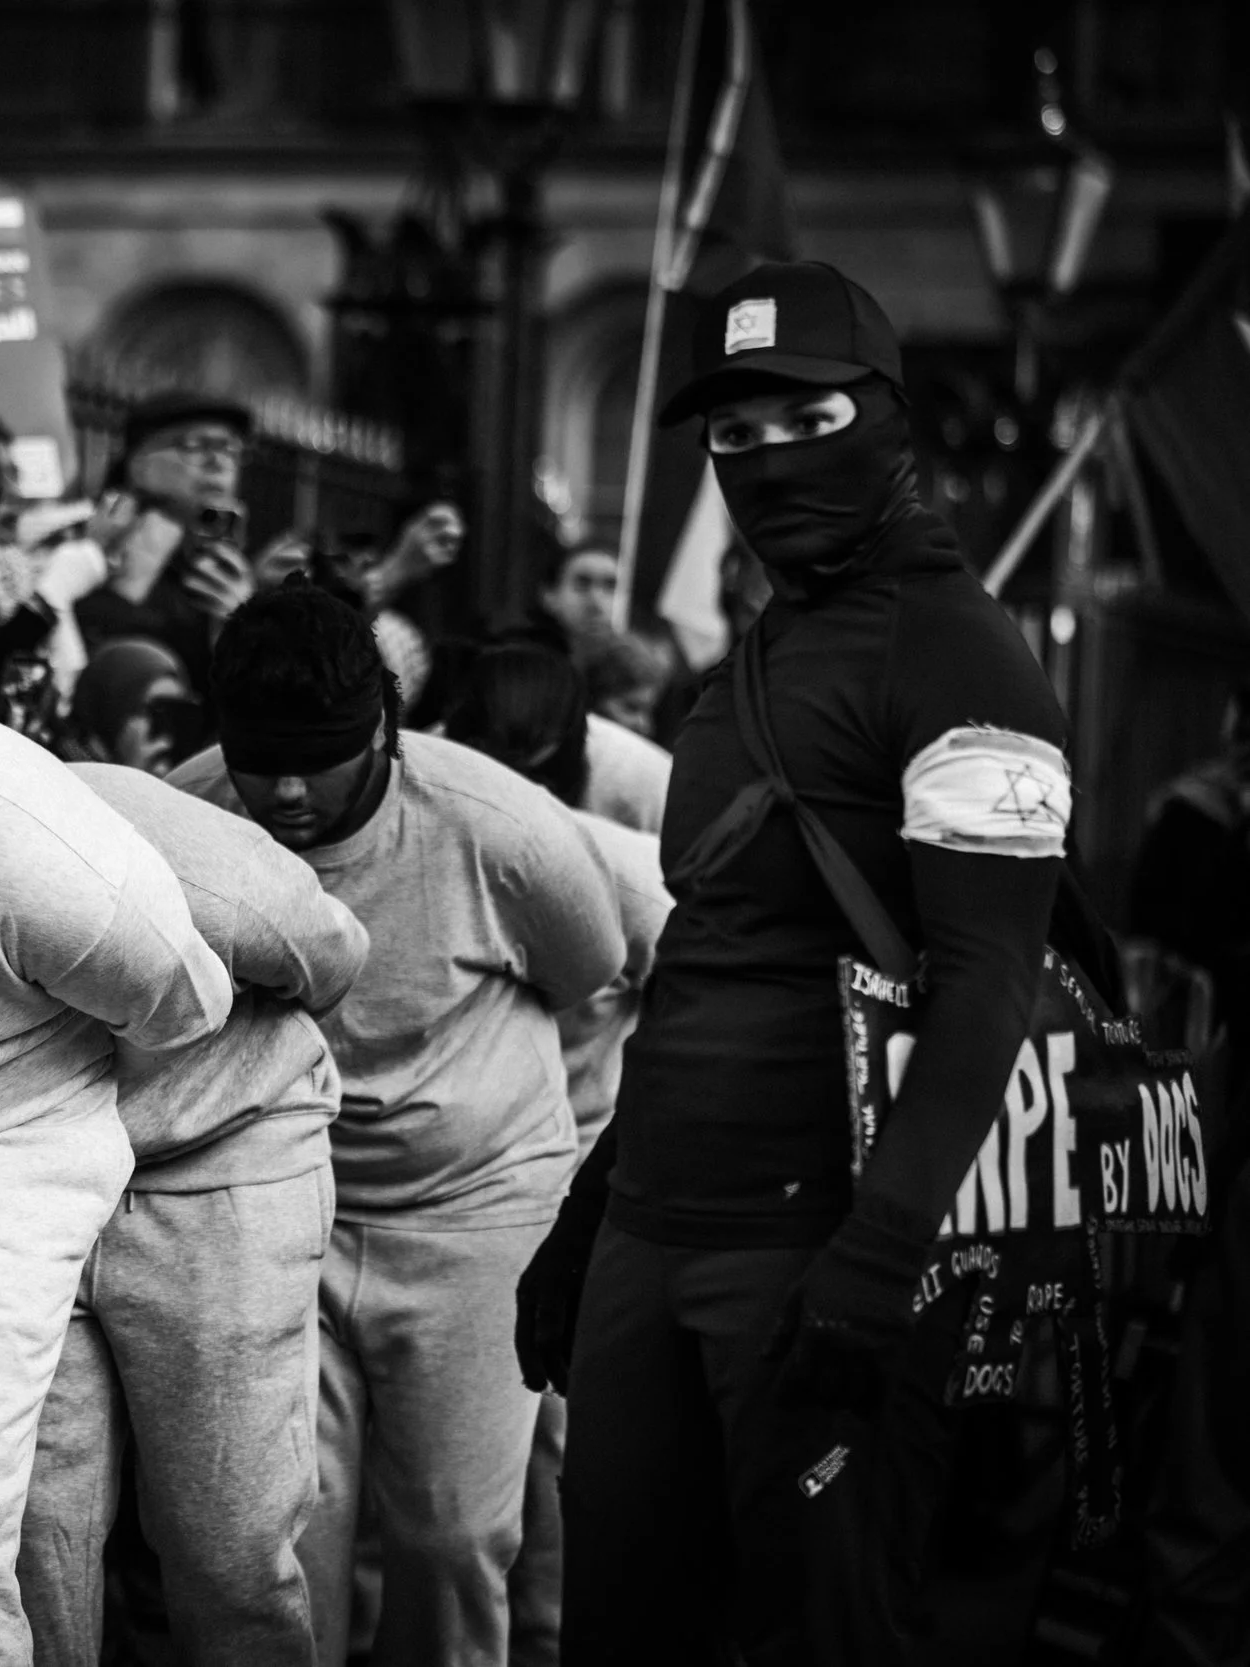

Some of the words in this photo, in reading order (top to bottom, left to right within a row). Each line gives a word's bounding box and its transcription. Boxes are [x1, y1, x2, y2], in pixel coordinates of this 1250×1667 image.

[1100, 1137, 1131, 1215] BY
[1137, 1070, 1209, 1216] DOGS
[963, 1362, 1016, 1399] DOGS
